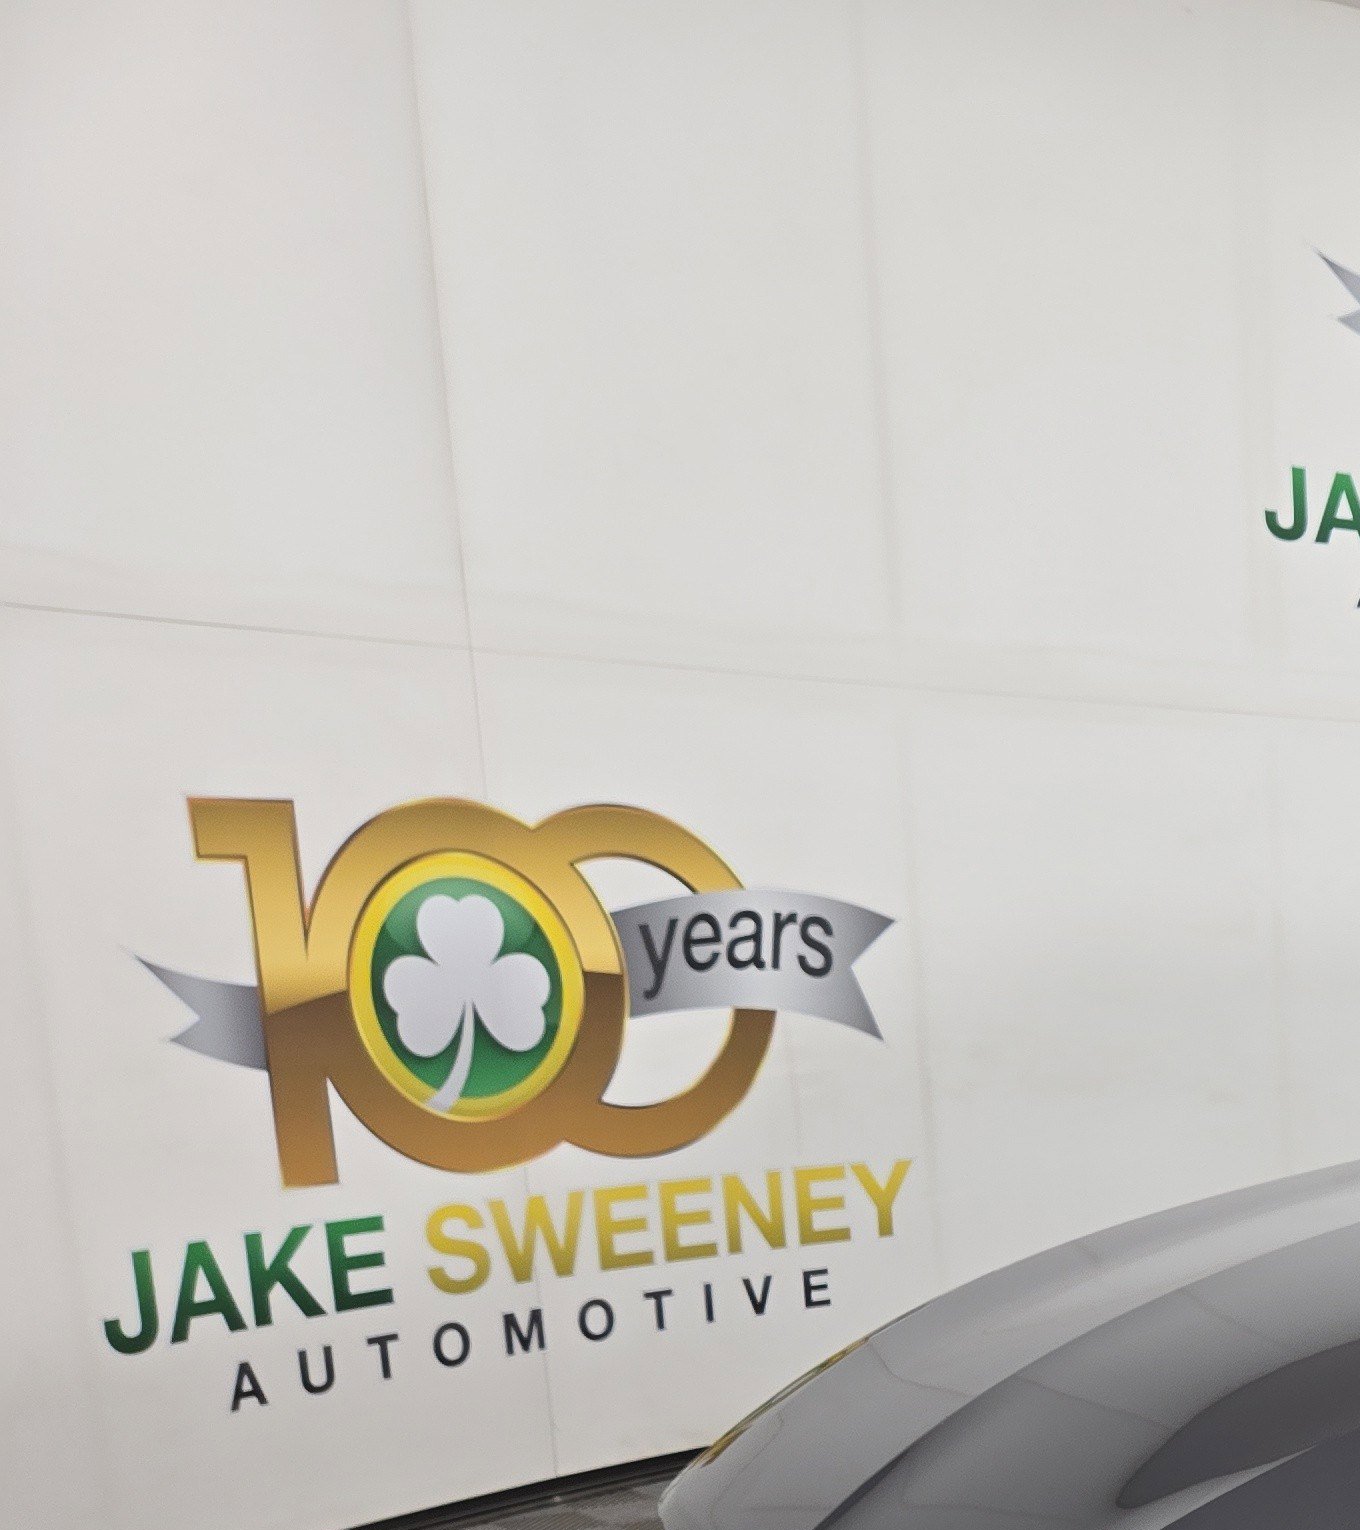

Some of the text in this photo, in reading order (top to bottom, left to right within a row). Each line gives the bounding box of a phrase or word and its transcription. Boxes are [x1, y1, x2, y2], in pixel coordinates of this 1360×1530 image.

[637, 909, 836, 1001] years
[104, 1159, 912, 1356] JAKE SWEENEY
[229, 1268, 833, 1414] AUTOMOTIVE
